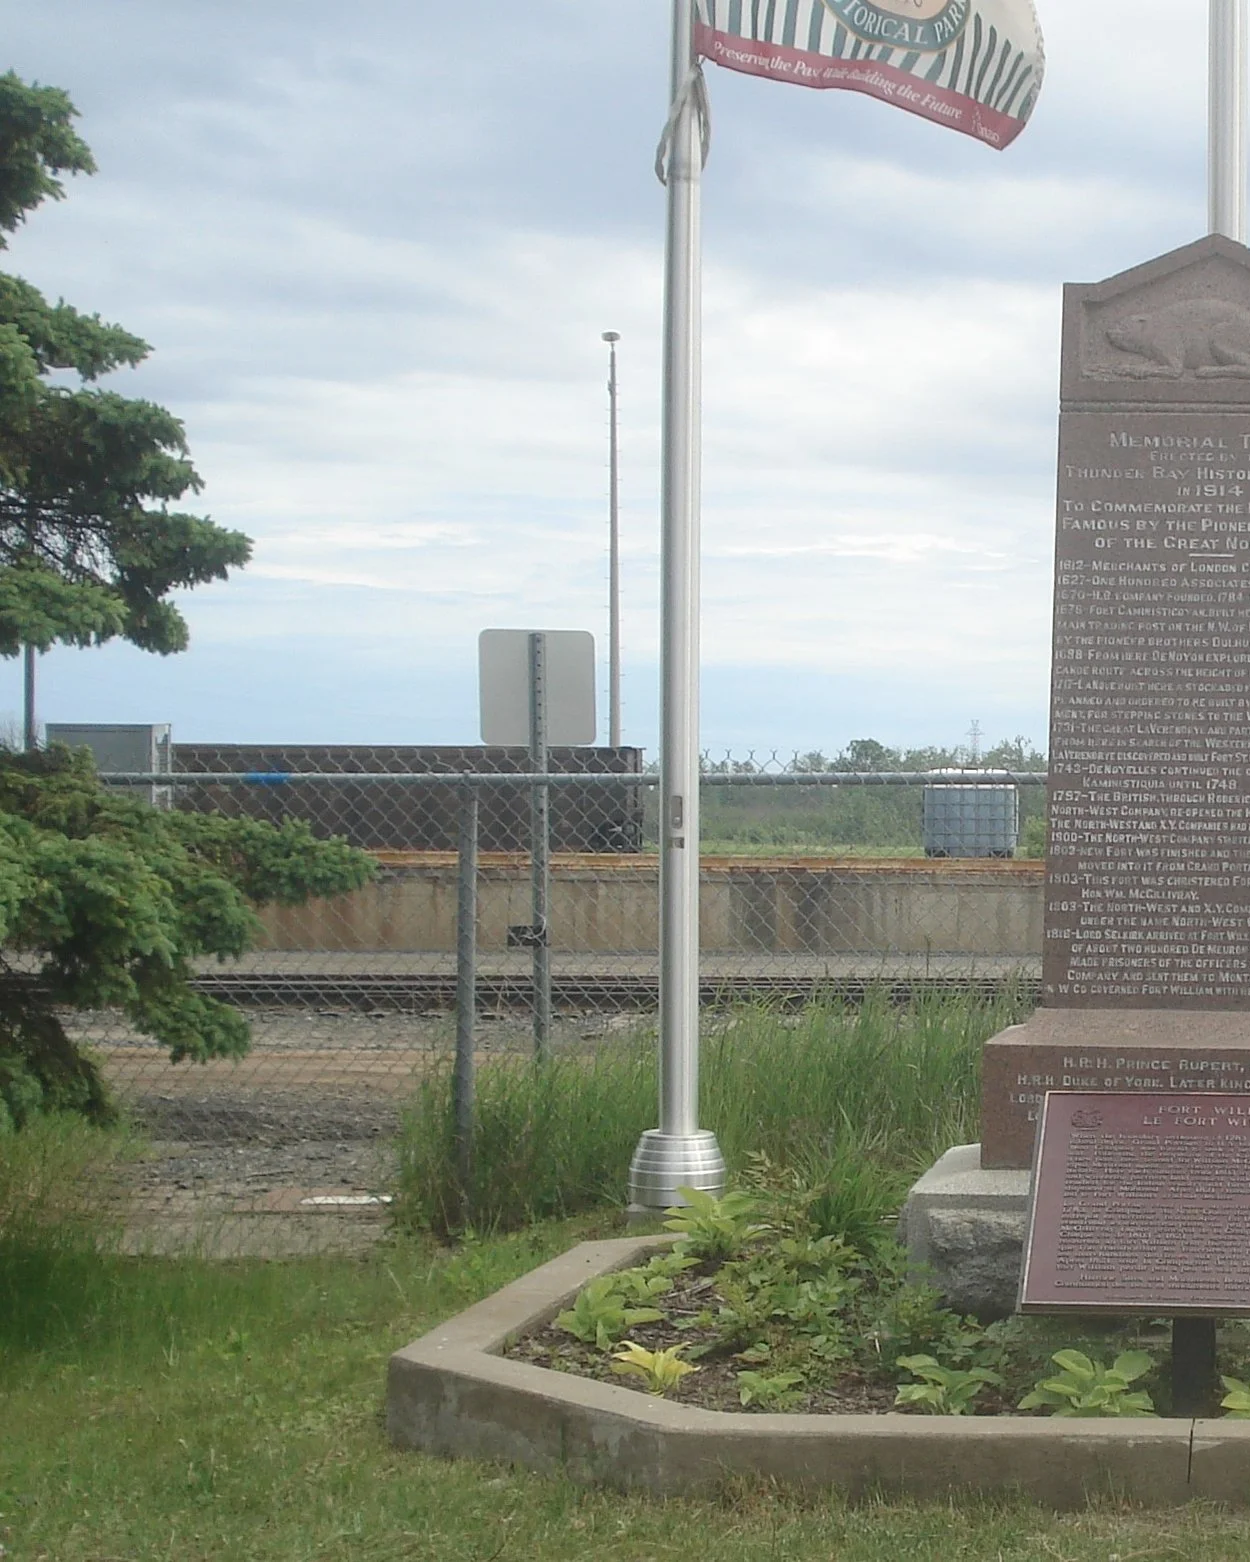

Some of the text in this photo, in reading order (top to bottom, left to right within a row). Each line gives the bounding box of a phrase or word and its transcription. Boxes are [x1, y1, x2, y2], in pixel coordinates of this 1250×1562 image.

[897, 83, 920, 102] the
[921, 93, 963, 120] Future
[1110, 432, 1228, 449] MEMORIAL
[1065, 465, 1145, 479] THUNDER
[1152, 466, 1189, 480] BAY
[1177, 484, 1244, 498] IN 1914
[1063, 500, 1084, 512] TO
[1091, 500, 1213, 514] COMMEMORATE
[1217, 504, 1245, 515] THE
[1063, 516, 1130, 531] FAMOUS
[1136, 519, 1159, 531] BY
[1166, 520, 1197, 531] THE
[1094, 537, 1117, 549] OF
[1124, 538, 1157, 550] THE
[1163, 536, 1220, 551] GREAT
[1171, 562, 1187, 572] OF
[1190, 561, 1237, 573] LONDON
[1119, 575, 1177, 588] HUNDRED
[1075, 636, 1094, 646] THE
[1148, 637, 1209, 648] BROTHERS
[1160, 766, 1241, 777] CONTINUED THE
[1082, 777, 1238, 790] KAMINISTIQUIA UNTIL 1748
[1051, 804, 1119, 817] NORTH-WEST
[1049, 818, 1071, 829] THE
[1078, 861, 1115, 872] MOVED
[1143, 861, 1154, 871] IT
[1155, 861, 1185, 872] FROM
[1107, 902, 1179, 914] NORTH-WEST
[1181, 904, 1201, 914] AND
[1080, 916, 1115, 926] UNDER
[1117, 916, 1137, 926] THE
[1120, 943, 1143, 954] TWO
[1158, 958, 1171, 968] OF
[1122, 971, 1144, 981] AND
[1170, 973, 1199, 982] THEM
[1201, 974, 1215, 983] TO
[1141, 984, 1169, 995] FORT
[1169, 984, 1214, 996] WILLIAM
[1115, 1057, 1171, 1071] PRINCE
[1062, 1075, 1098, 1088] DUKE
[1104, 1077, 1121, 1087] OF
[1169, 1075, 1218, 1089] LATER
[1159, 1104, 1202, 1115] FORT
[1142, 1115, 1162, 1126] LE
[1173, 1116, 1218, 1127] FORT
